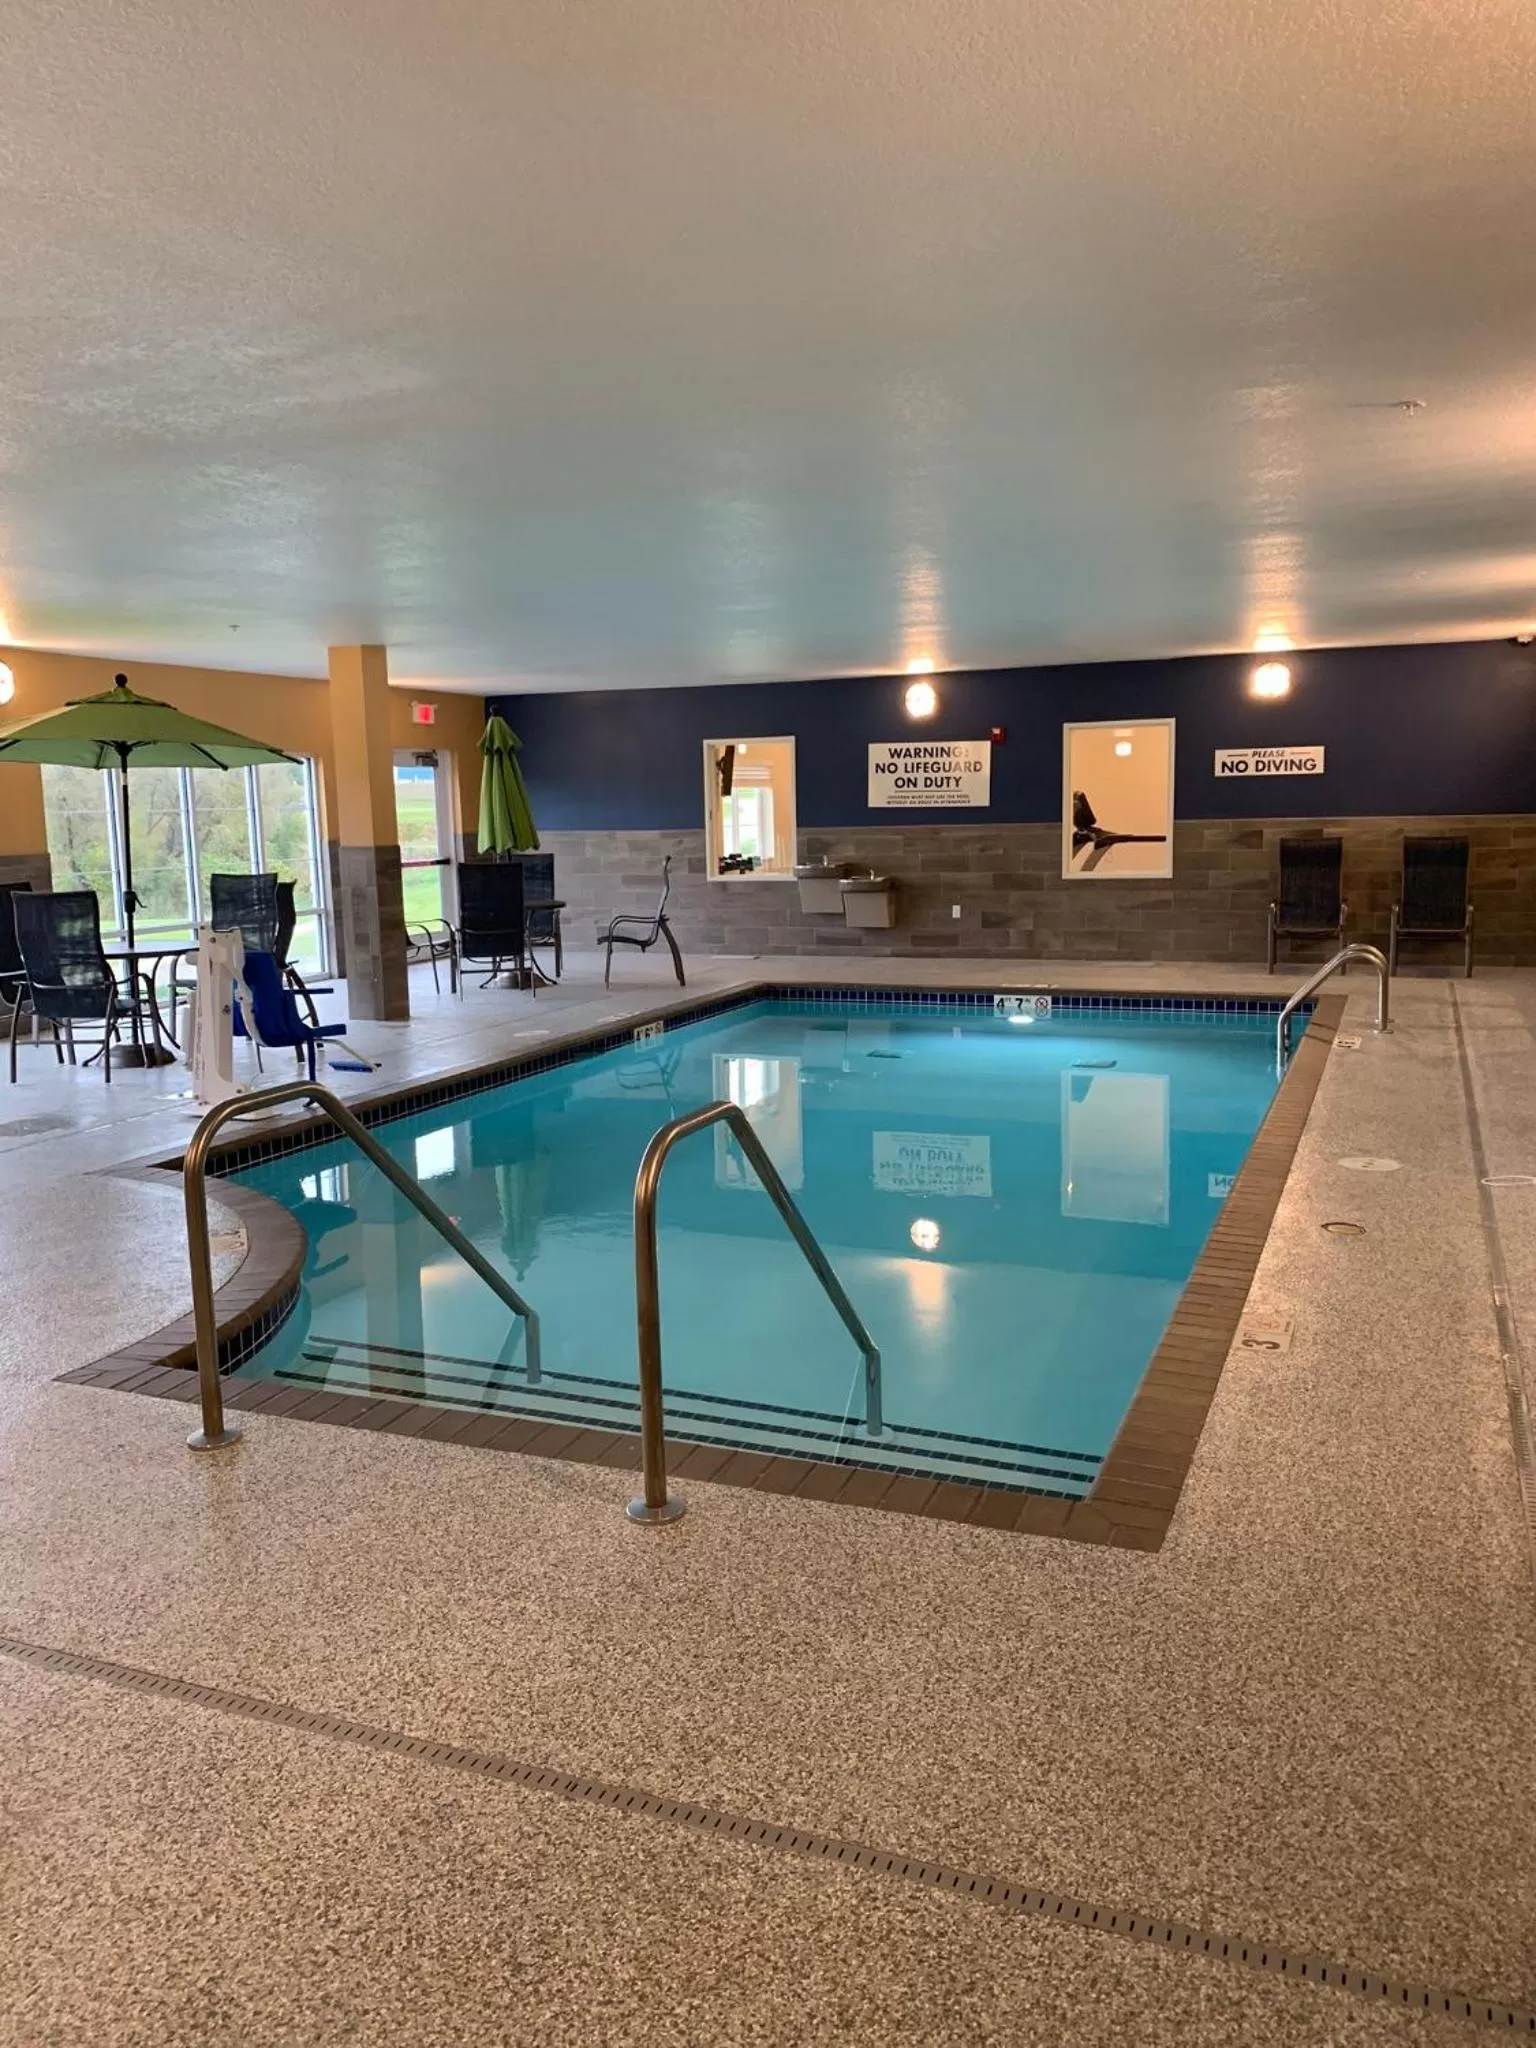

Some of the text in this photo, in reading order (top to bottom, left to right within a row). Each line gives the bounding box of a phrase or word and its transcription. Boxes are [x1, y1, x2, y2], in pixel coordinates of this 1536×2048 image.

[888, 746, 969, 759] WARNING:
[1251, 750, 1286, 759] PLEASE
[875, 761, 983, 774] NO LIFEGUARD
[1221, 758, 1317, 774] NO DIVING
[894, 776, 962, 789] ON DUTY
[1242, 1339, 1280, 1350] 3
